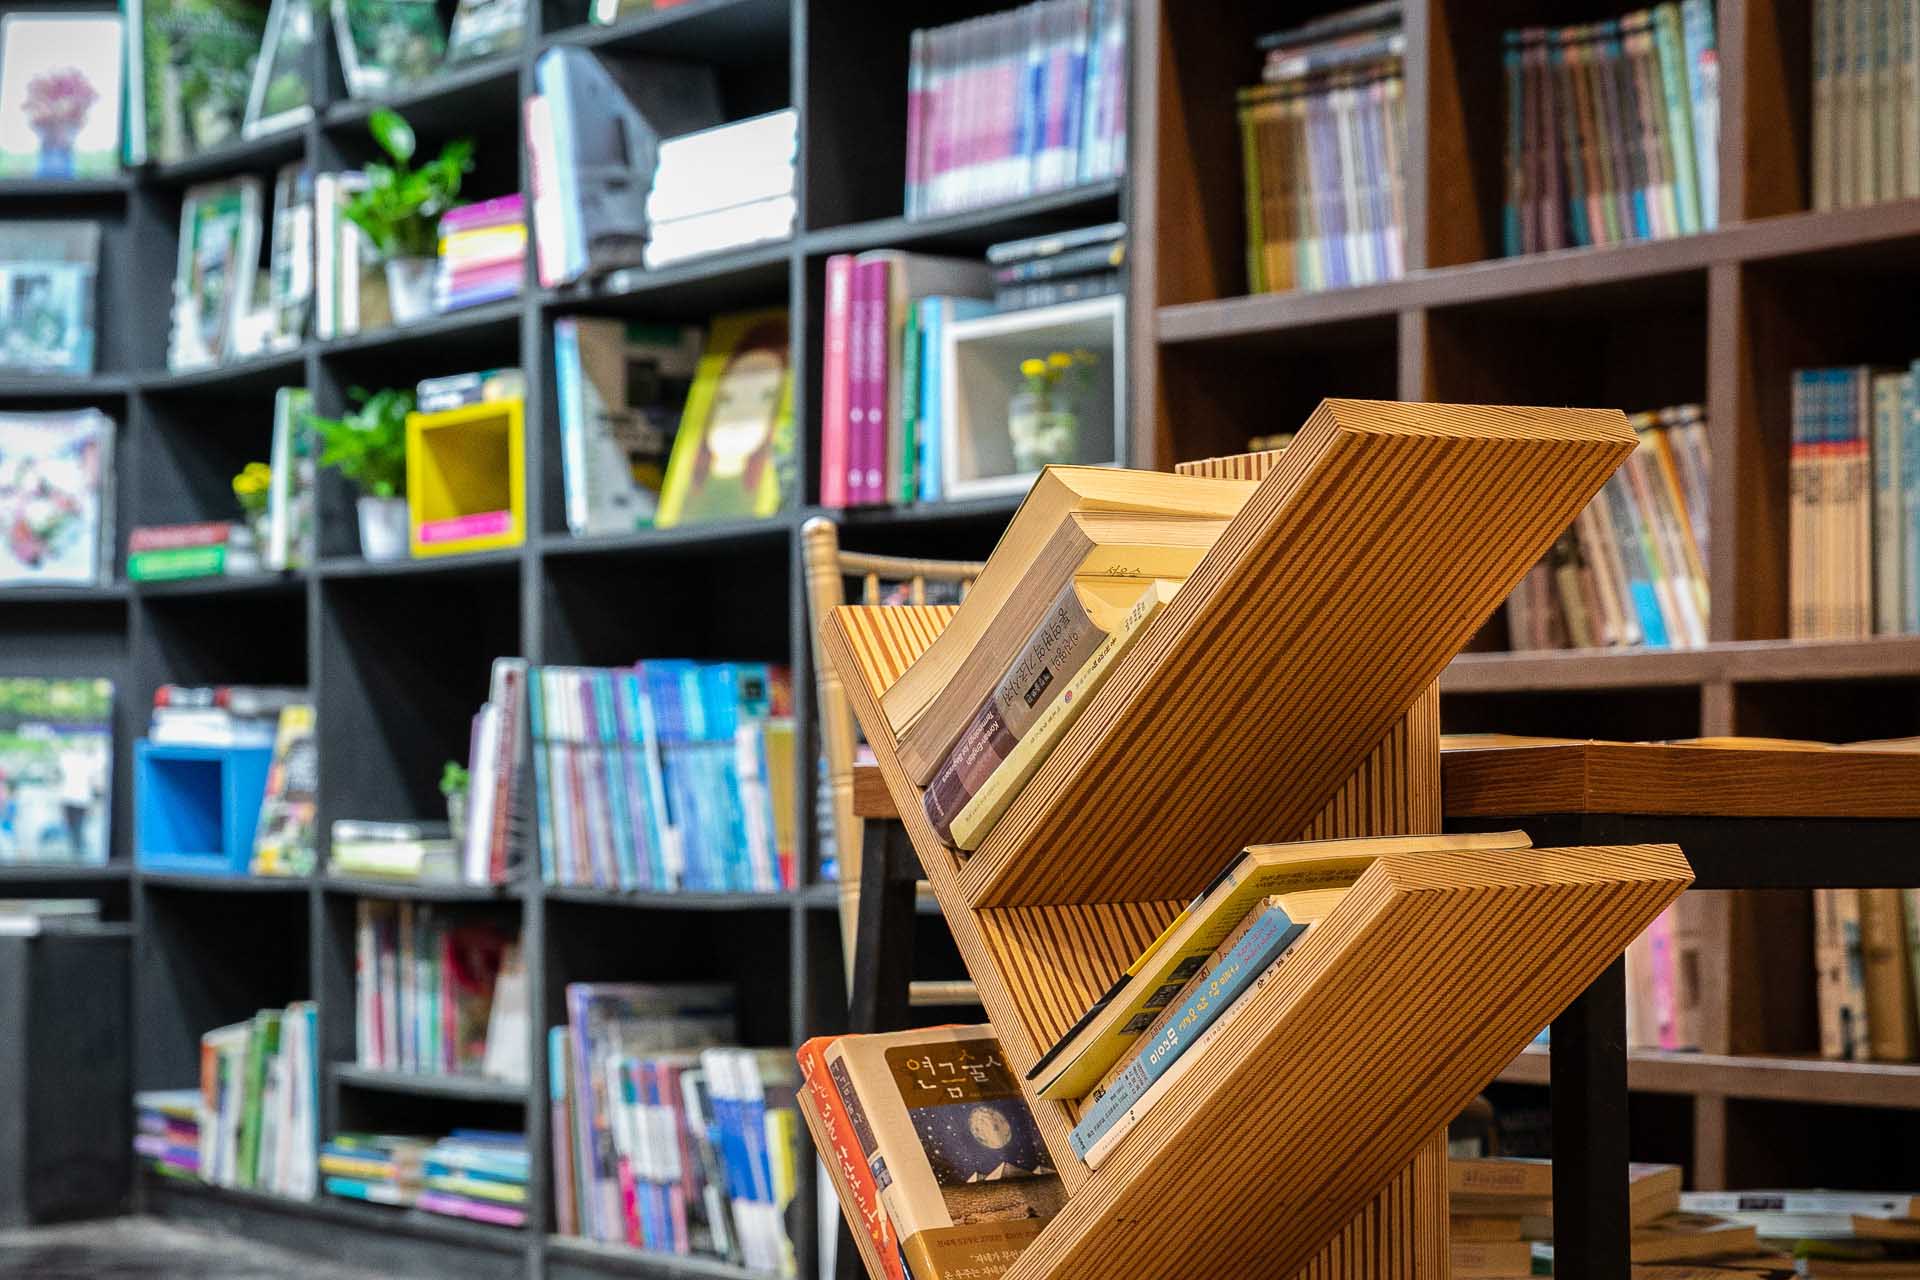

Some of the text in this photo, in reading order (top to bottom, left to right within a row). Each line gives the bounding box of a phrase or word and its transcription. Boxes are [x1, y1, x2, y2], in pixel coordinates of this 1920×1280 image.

[1033, 607, 1071, 663] 통역번역
[1051, 632, 1079, 671] 이진영의
[1001, 654, 1036, 707] 기초사전
[966, 720, 1000, 765] Korean-English
[967, 711, 994, 746] Terminology
[1150, 1027, 1179, 1065] 맑음
